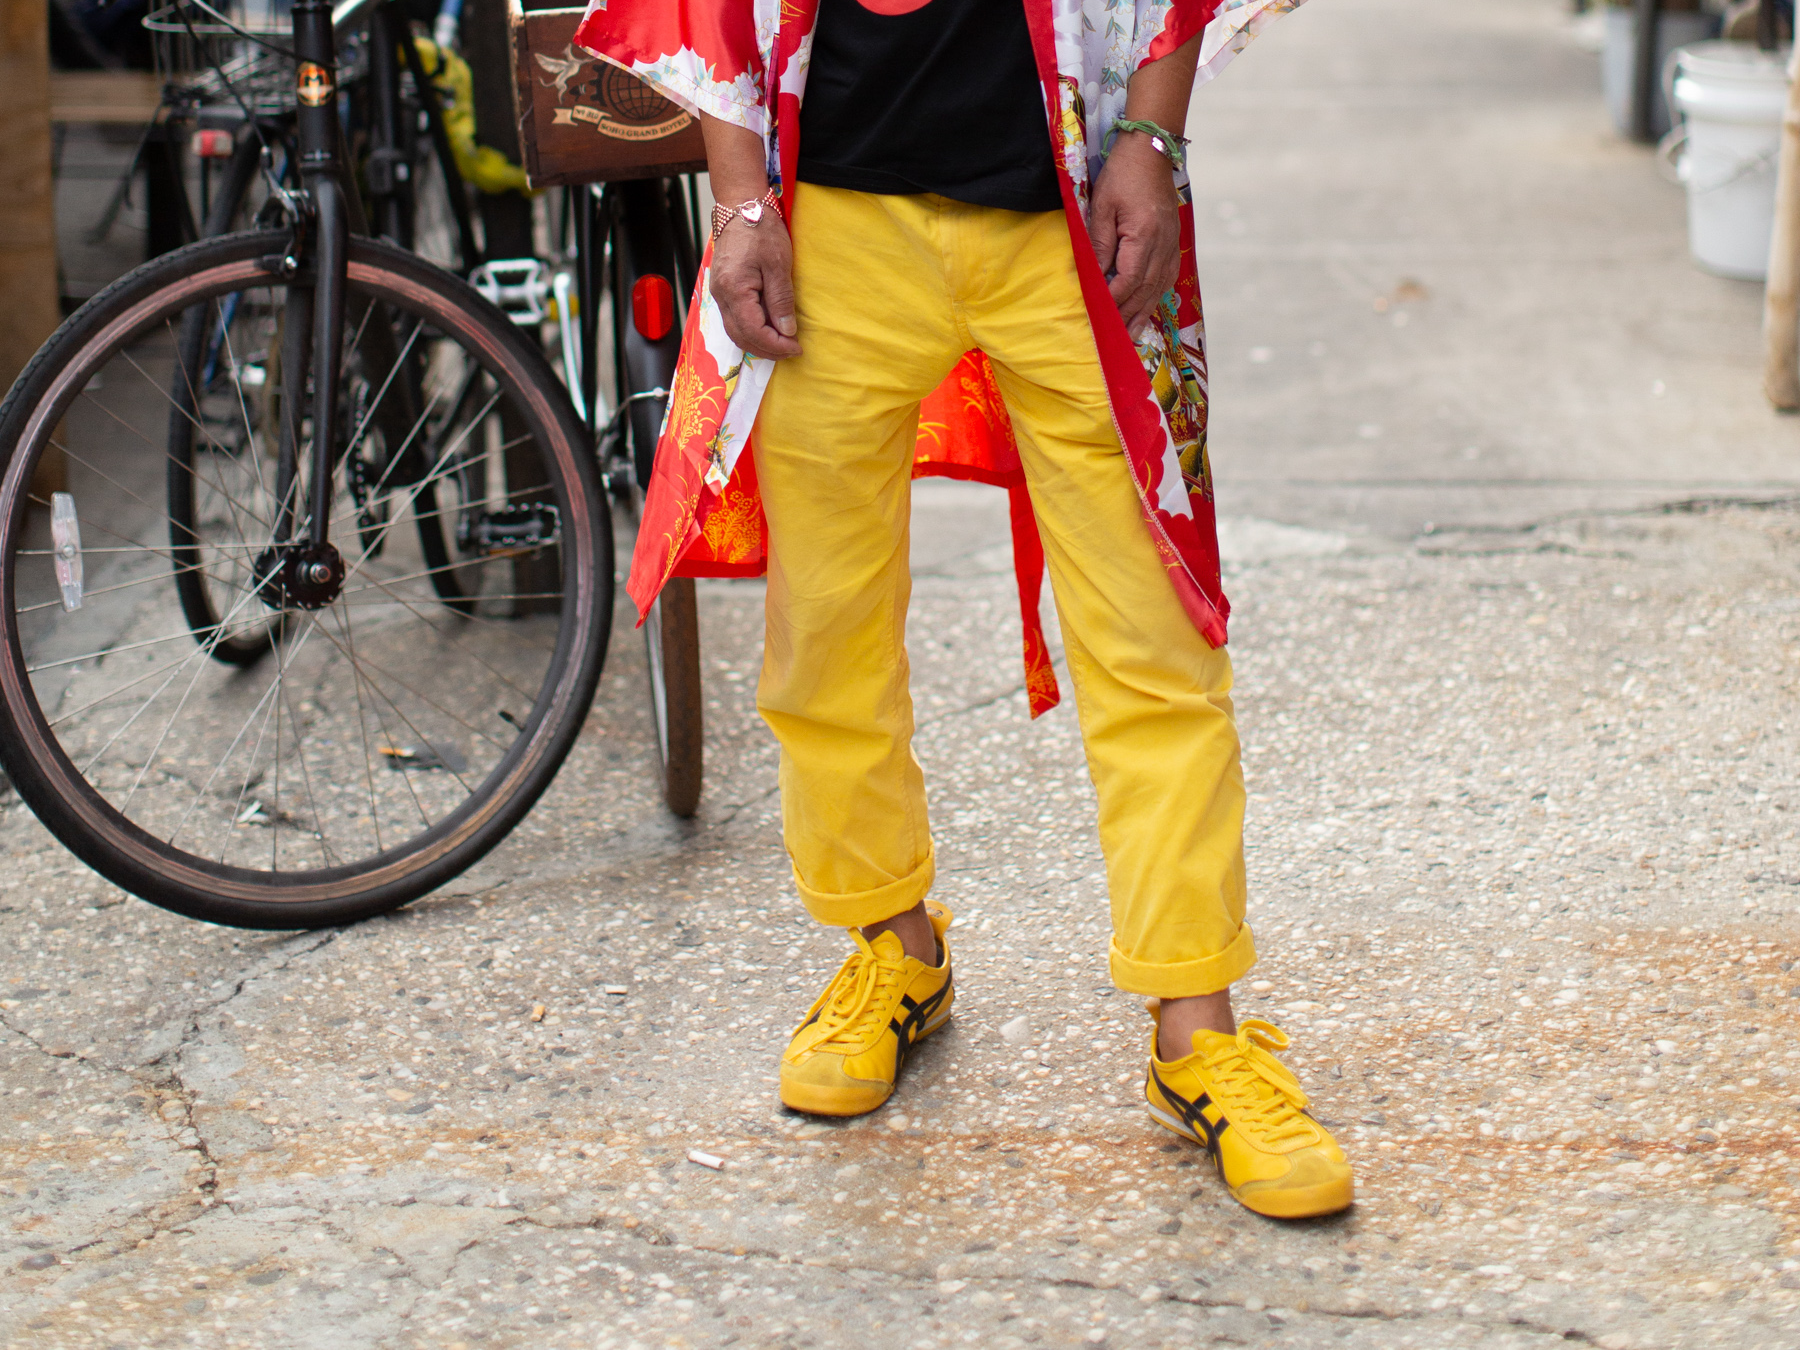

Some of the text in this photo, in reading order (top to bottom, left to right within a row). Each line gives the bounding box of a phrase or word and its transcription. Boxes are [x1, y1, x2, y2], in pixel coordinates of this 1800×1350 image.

[600, 116, 689, 138] SOHO GRAND HOTEL
